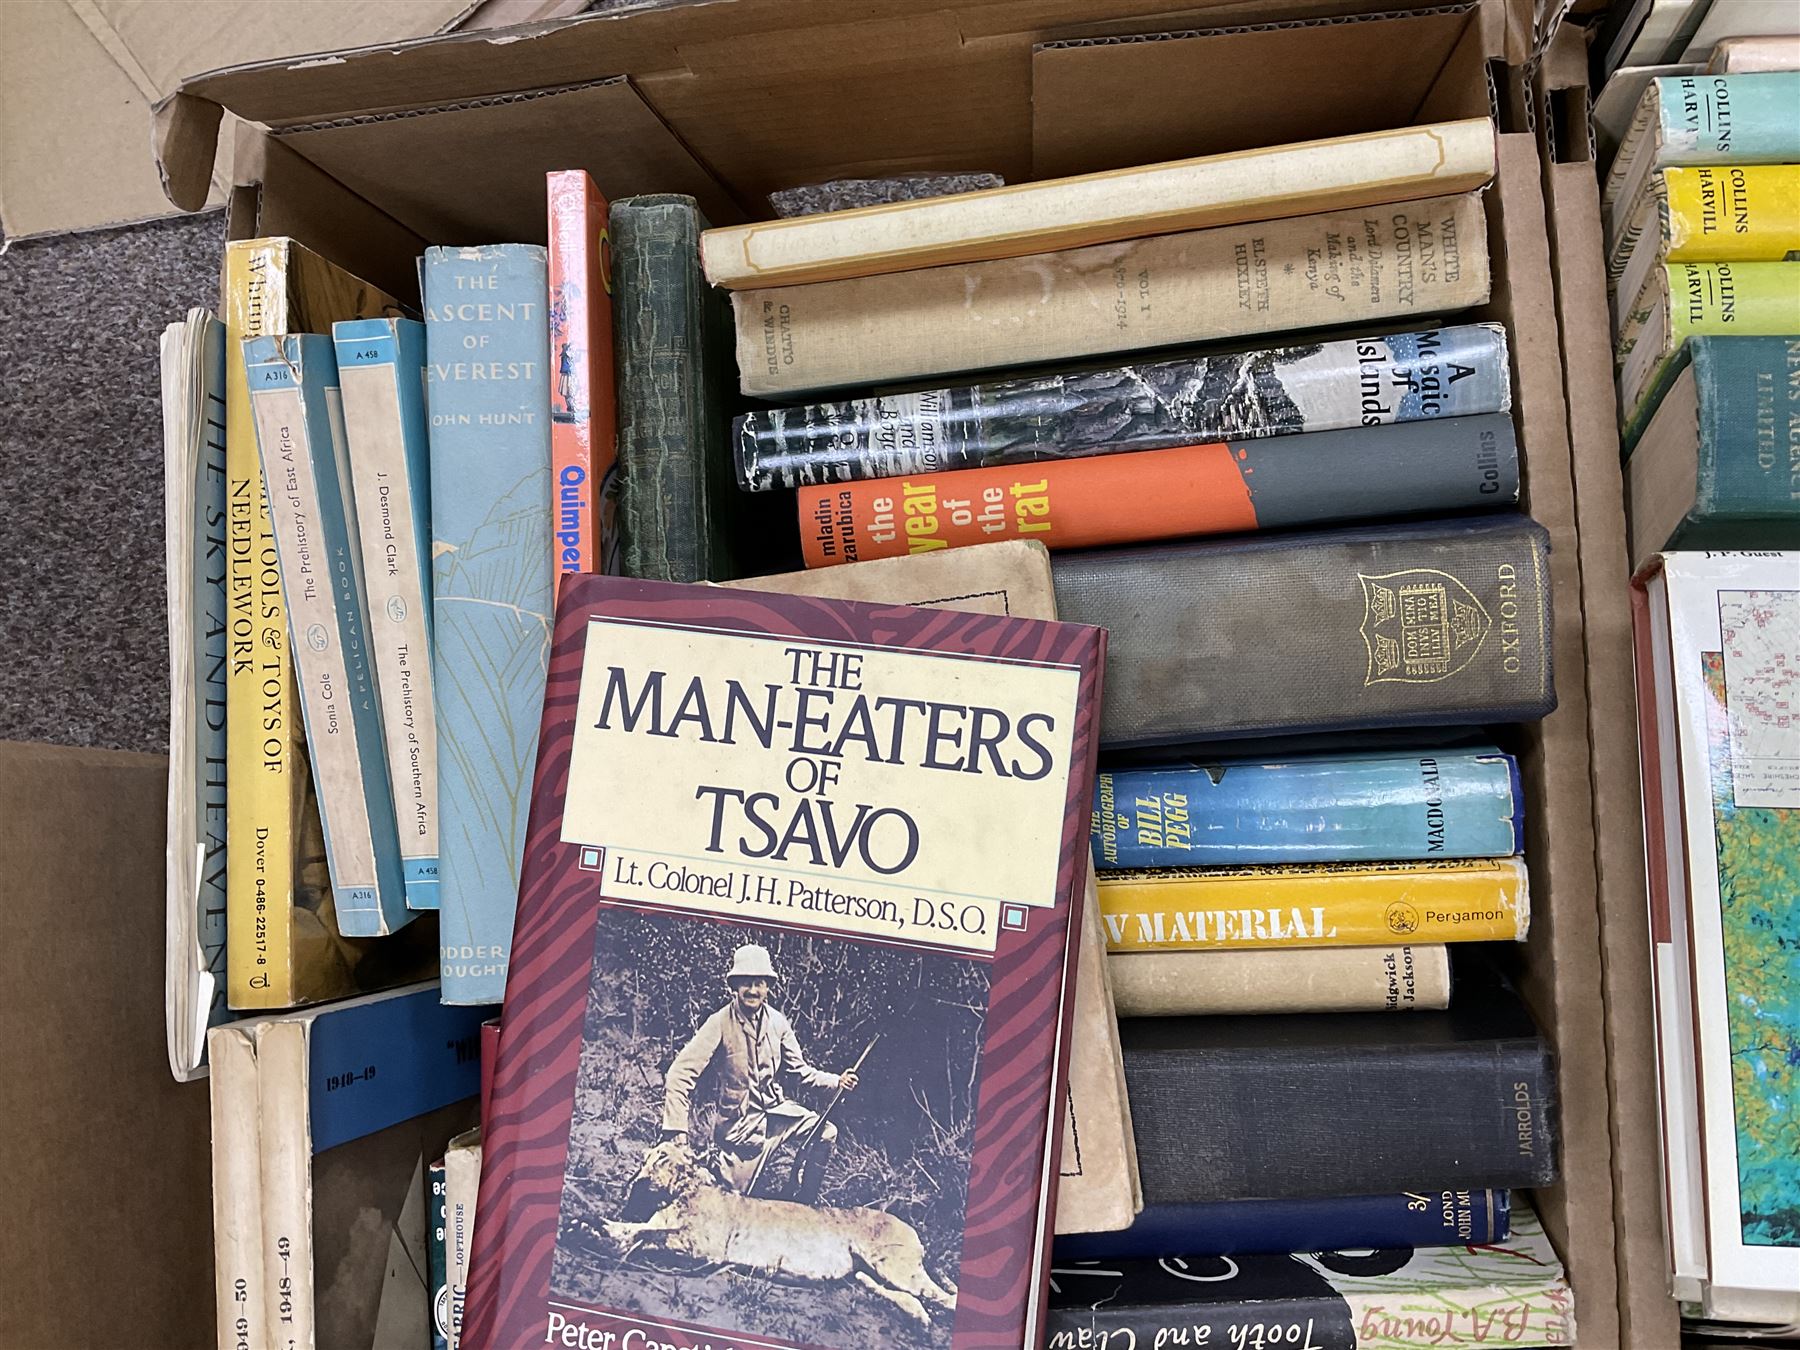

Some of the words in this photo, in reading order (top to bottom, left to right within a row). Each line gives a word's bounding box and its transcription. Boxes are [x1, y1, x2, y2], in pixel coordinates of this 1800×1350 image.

[1681, 78, 1699, 140] HARV
[1714, 79, 1731, 152] COLLINS
[1699, 169, 1717, 235] HARVILL
[1730, 169, 1748, 234] COLLINS
[1324, 232, 1344, 281] Making
[1347, 237, 1362, 262] and
[1363, 219, 1380, 248] Lord
[1417, 221, 1437, 284] MAN'S
[1440, 216, 1461, 283] WHITE
[455, 276, 499, 290] THE
[1234, 242, 1252, 309] HUXLEY
[1252, 238, 1270, 312] ELSPETH
[1305, 248, 1321, 291] Kenya
[1350, 266, 1362, 287] the
[1392, 214, 1414, 306] COUNTRY
[427, 303, 537, 322] ASCENT
[763, 301, 773, 313] &
[1325, 284, 1346, 302] of
[463, 335, 490, 348] OF
[764, 316, 779, 375] WINDUS
[779, 304, 793, 365] CHATTO
[428, 362, 537, 381] EVEREST
[1356, 337, 1391, 426] Islands
[1392, 365, 1419, 394] of
[1415, 331, 1448, 415] Mosaic
[1446, 363, 1475, 385] A
[479, 413, 535, 425] HUNT
[920, 391, 939, 473] Williamson
[281, 426, 294, 462] Africa
[1477, 431, 1499, 495] Collins
[286, 467, 299, 493] East
[377, 472, 387, 481] J.
[293, 494, 302, 508] of
[379, 486, 395, 540] Desmond
[867, 496, 897, 544] the
[903, 482, 948, 554] year
[943, 498, 971, 526] of
[977, 487, 1006, 534] the
[1010, 479, 1052, 533] rat
[206, 505, 227, 590] SKY
[291, 512, 313, 575] Prehistory
[816, 497, 836, 557] mladin
[836, 490, 858, 563] zarubica
[231, 479, 254, 676] NEEDLEWORK
[337, 546, 350, 600] BOOK
[386, 544, 399, 576] Clark
[304, 578, 317, 601] The
[262, 627, 282, 650] &
[1498, 564, 1521, 674] OXFORD
[206, 611, 227, 732] AND
[347, 611, 366, 694] PELICAN
[398, 644, 408, 666] The
[785, 647, 863, 690] THE
[262, 655, 282, 732] TOYS
[320, 673, 334, 700] Cole
[401, 670, 415, 729] Prehistory
[327, 704, 339, 734] Sonia
[408, 732, 419, 743] of
[594, 665, 1054, 780] MAN-EATERS
[264, 738, 283, 774] OF
[409, 746, 422, 798] Southern
[786, 757, 841, 796] OF
[416, 801, 427, 836] Africa
[1117, 813, 1130, 830] OF
[1135, 795, 1163, 848] BILL
[1163, 792, 1191, 850] PEGG
[1419, 758, 1445, 853] MACDONALD
[256, 827, 269, 873] Dover
[696, 786, 919, 875] TSAVO
[614, 856, 643, 888] Lt.
[648, 862, 733, 898] Colonel
[788, 880, 904, 929] Patterson,
[912, 898, 986, 936] D.S.O.
[1425, 909, 1504, 925] Pergamon
[1135, 907, 1337, 944] MATERIAL
[1403, 946, 1415, 1001] Jackson
[1514, 1081, 1534, 1157] JARROLDS
[1441, 1190, 1454, 1227] LOND
[1458, 1206, 1472, 1240] JOHN
[456, 1203, 464, 1267] LOFTHOUSE
[545, 1311, 616, 1350] Peter
[1154, 1326, 1212, 1350] and
[1230, 1317, 1323, 1350] Tooth
